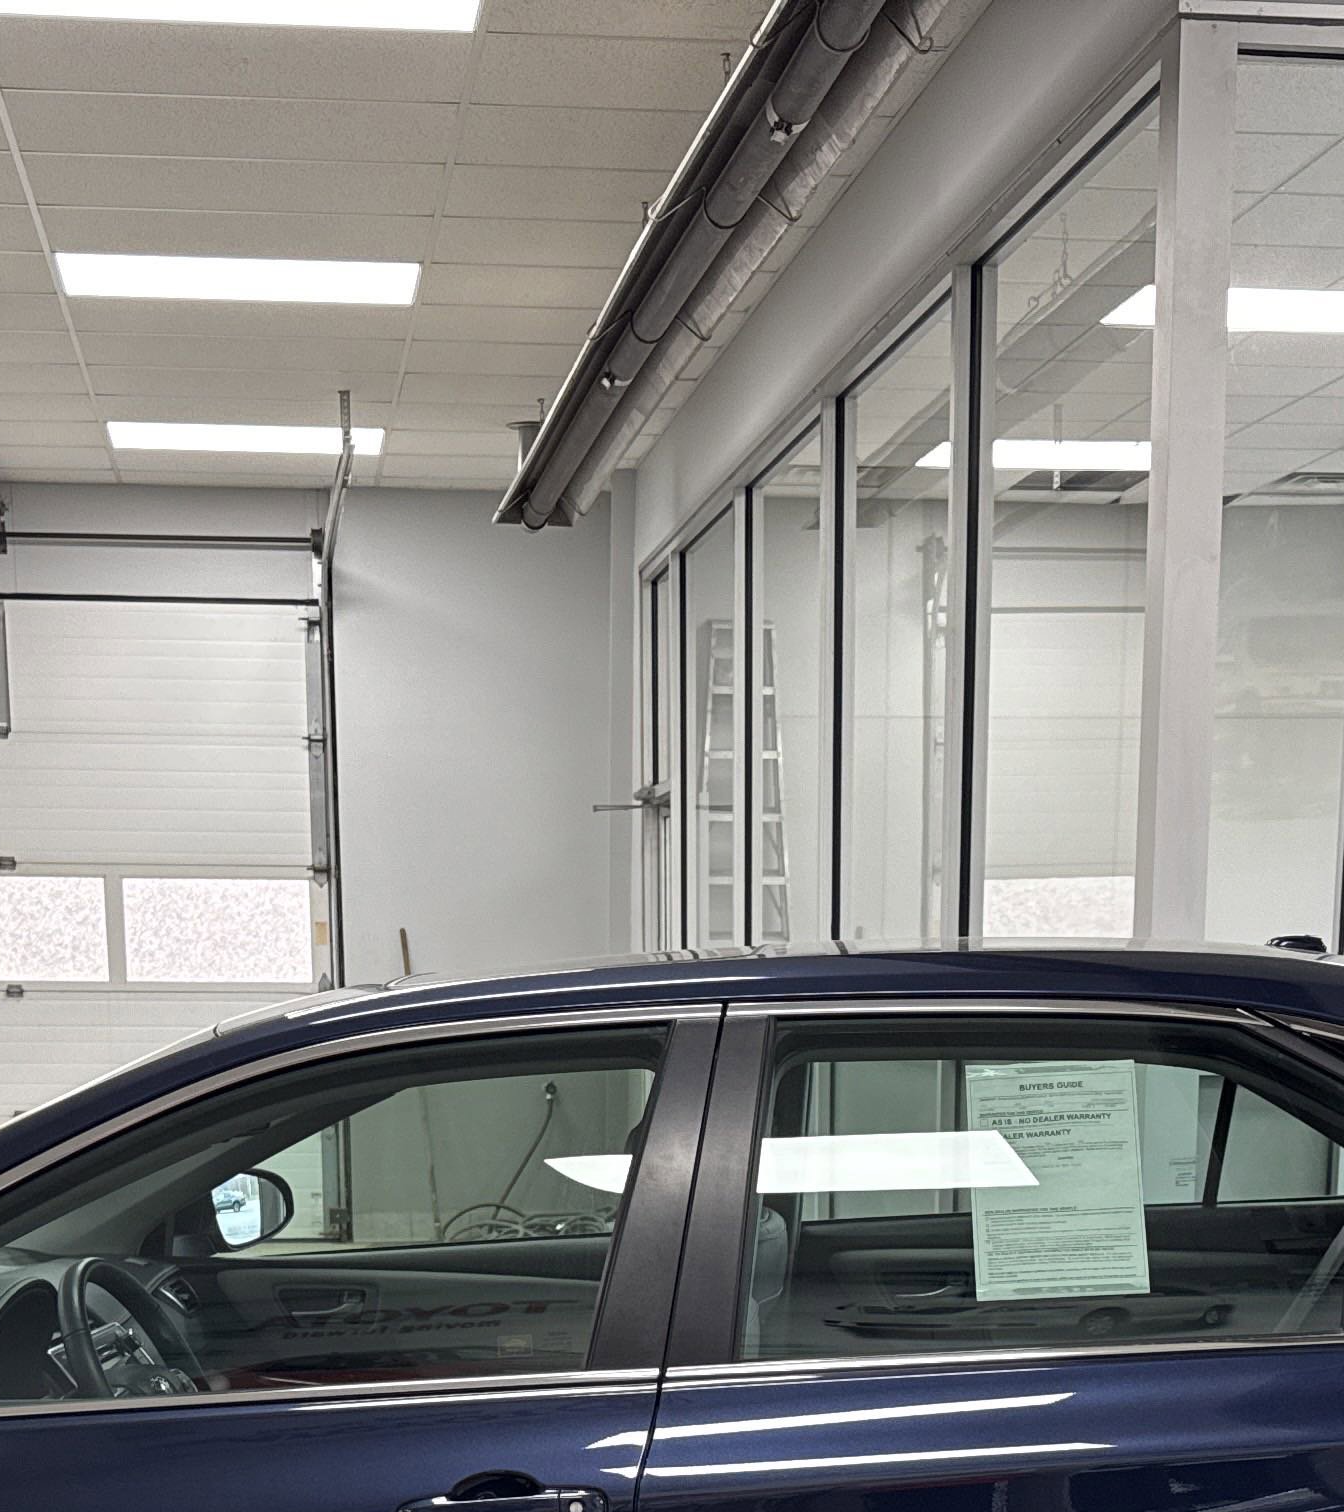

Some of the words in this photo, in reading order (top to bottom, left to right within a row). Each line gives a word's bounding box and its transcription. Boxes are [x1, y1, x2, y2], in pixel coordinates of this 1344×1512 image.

[1019, 1082, 1054, 1091] BUYERS
[1057, 1081, 1083, 1089] GUIDE
[1033, 1115, 1065, 1123] DEALER
[1067, 1113, 1112, 1121] WARRANTY
[1001, 1131, 1024, 1139] ALER
[1026, 1129, 1071, 1138] WARRANTY
